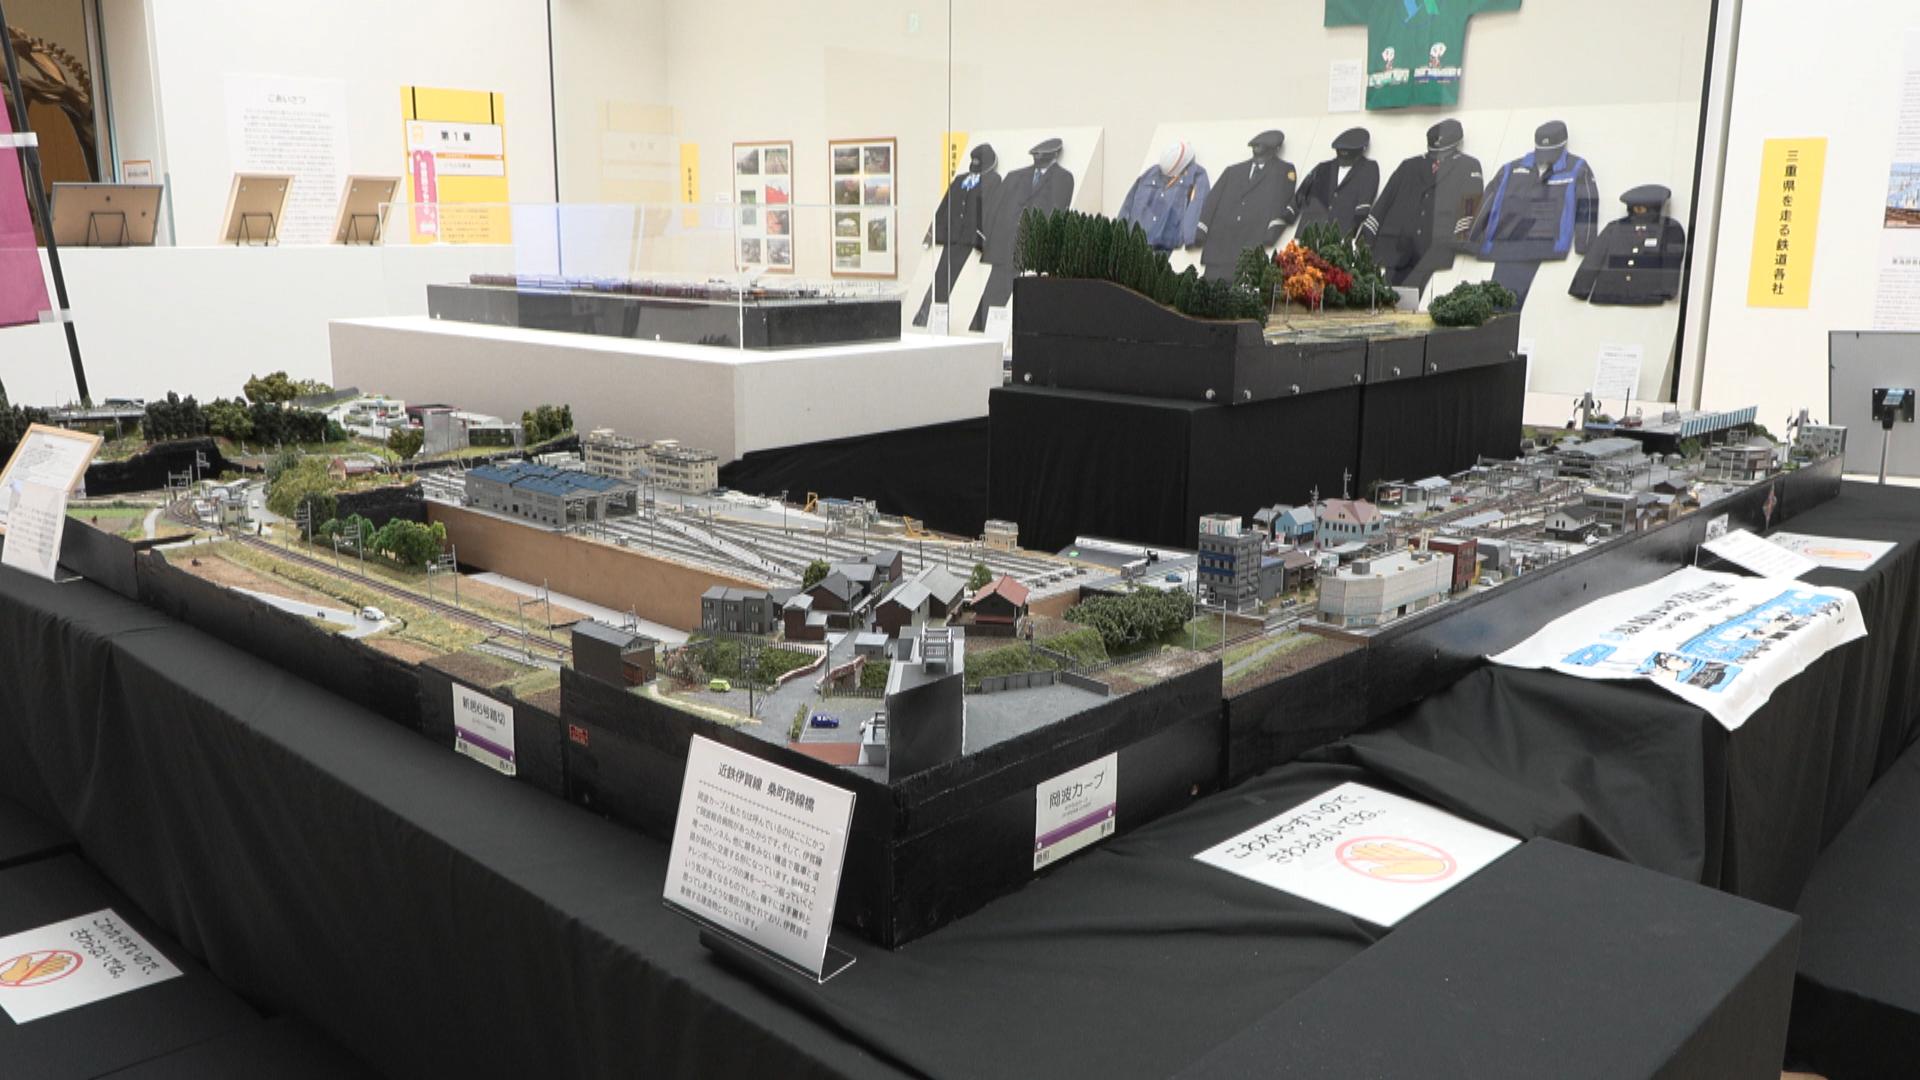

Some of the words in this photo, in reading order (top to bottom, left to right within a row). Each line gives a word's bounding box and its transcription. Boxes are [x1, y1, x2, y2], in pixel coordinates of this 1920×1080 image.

[1771, 149, 1799, 295] 三重県を走る鉄道各社
[718, 763, 762, 791] 近鉄伊賀線
[767, 782, 815, 811] 桑町跨線橋
